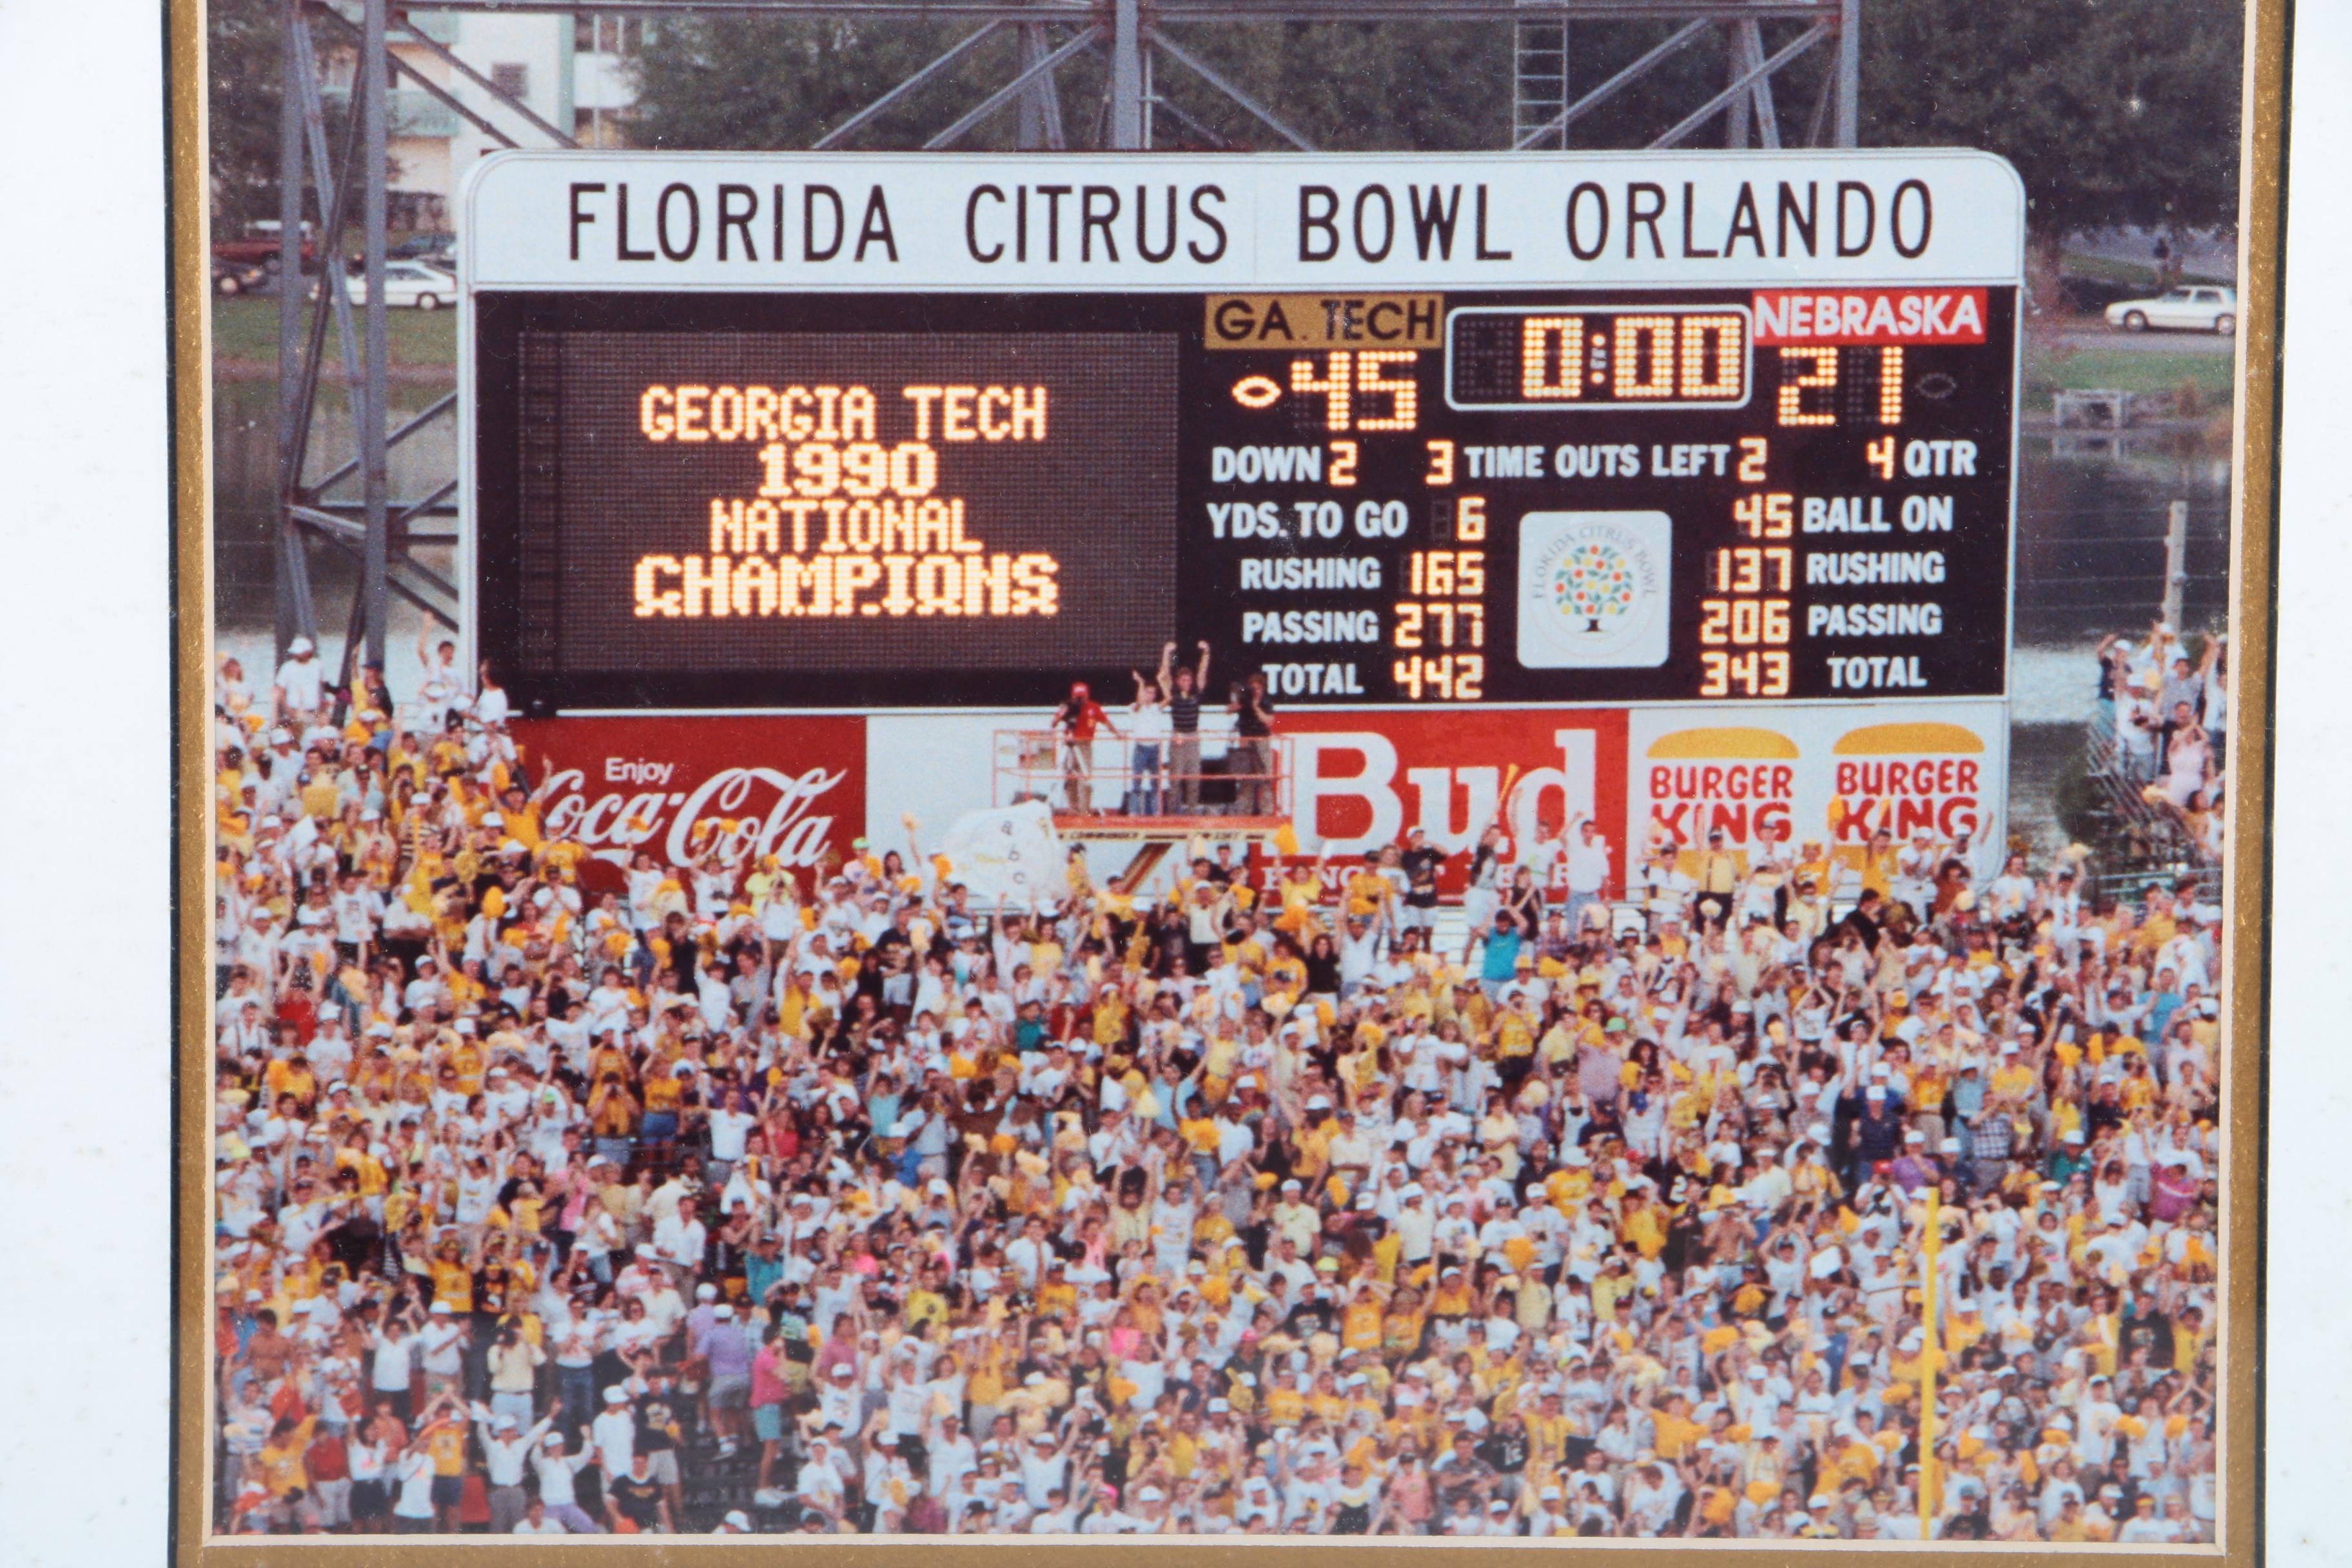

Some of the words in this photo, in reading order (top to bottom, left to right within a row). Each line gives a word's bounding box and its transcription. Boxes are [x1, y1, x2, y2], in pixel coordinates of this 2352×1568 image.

[569, 182, 899, 263] FLORIDA
[965, 183, 1228, 265] CITRUS
[1298, 183, 1513, 264] BOWL
[1565, 178, 1933, 262] ORLANDO
[1213, 299, 1308, 343] GA.
[1320, 299, 1436, 341] TECH
[1754, 295, 1983, 338] NEBRASKA
[1522, 315, 1741, 398] 0:00
[1290, 349, 1418, 431] 45
[1778, 345, 1903, 426] 21
[640, 384, 876, 444] GEORGIA
[904, 384, 1048, 444] TECH
[757, 443, 938, 498] 1990
[1211, 445, 1322, 484] DOWN
[1328, 440, 1358, 486] 2
[1425, 440, 1454, 485] 3
[1464, 445, 1545, 478] TIME
[1554, 444, 1641, 478] OUTS
[1651, 444, 1731, 477] LEFT
[1738, 437, 1767, 482] 2
[1867, 435, 1895, 480] 4
[1904, 439, 1977, 478] QTR
[709, 499, 984, 554] NATIONAL
[1206, 501, 1289, 539] YDS.
[1295, 500, 1344, 538] TO
[1355, 500, 1409, 538] GO
[1456, 496, 1485, 542] 6
[1734, 493, 1793, 538] 45
[1802, 496, 1892, 533] BALL
[1901, 495, 1954, 533] ON
[633, 554, 1059, 617] CHAMPIONS
[1240, 556, 1382, 591] RUSHING
[1411, 550, 1485, 596] 165
[1717, 546, 1792, 593] 137
[1806, 551, 1946, 585] RUSHING
[1242, 609, 1379, 643] PASSING
[1394, 602, 1484, 649] 277
[1700, 598, 1790, 645] 206
[1807, 602, 1943, 636] PASSING
[1261, 663, 1364, 696] TOTAL
[1393, 654, 1484, 700] 442
[1700, 650, 1790, 696] 343
[1827, 656, 1928, 689] TOTAL
[605, 758, 674, 785] Enjoy
[1261, 729, 1596, 856] Bud
[1650, 765, 1794, 799] BURGER
[1836, 759, 1979, 796] BURGER
[530, 767, 848, 868] Coca-Cola
[1261, 865, 1366, 890] KNG
